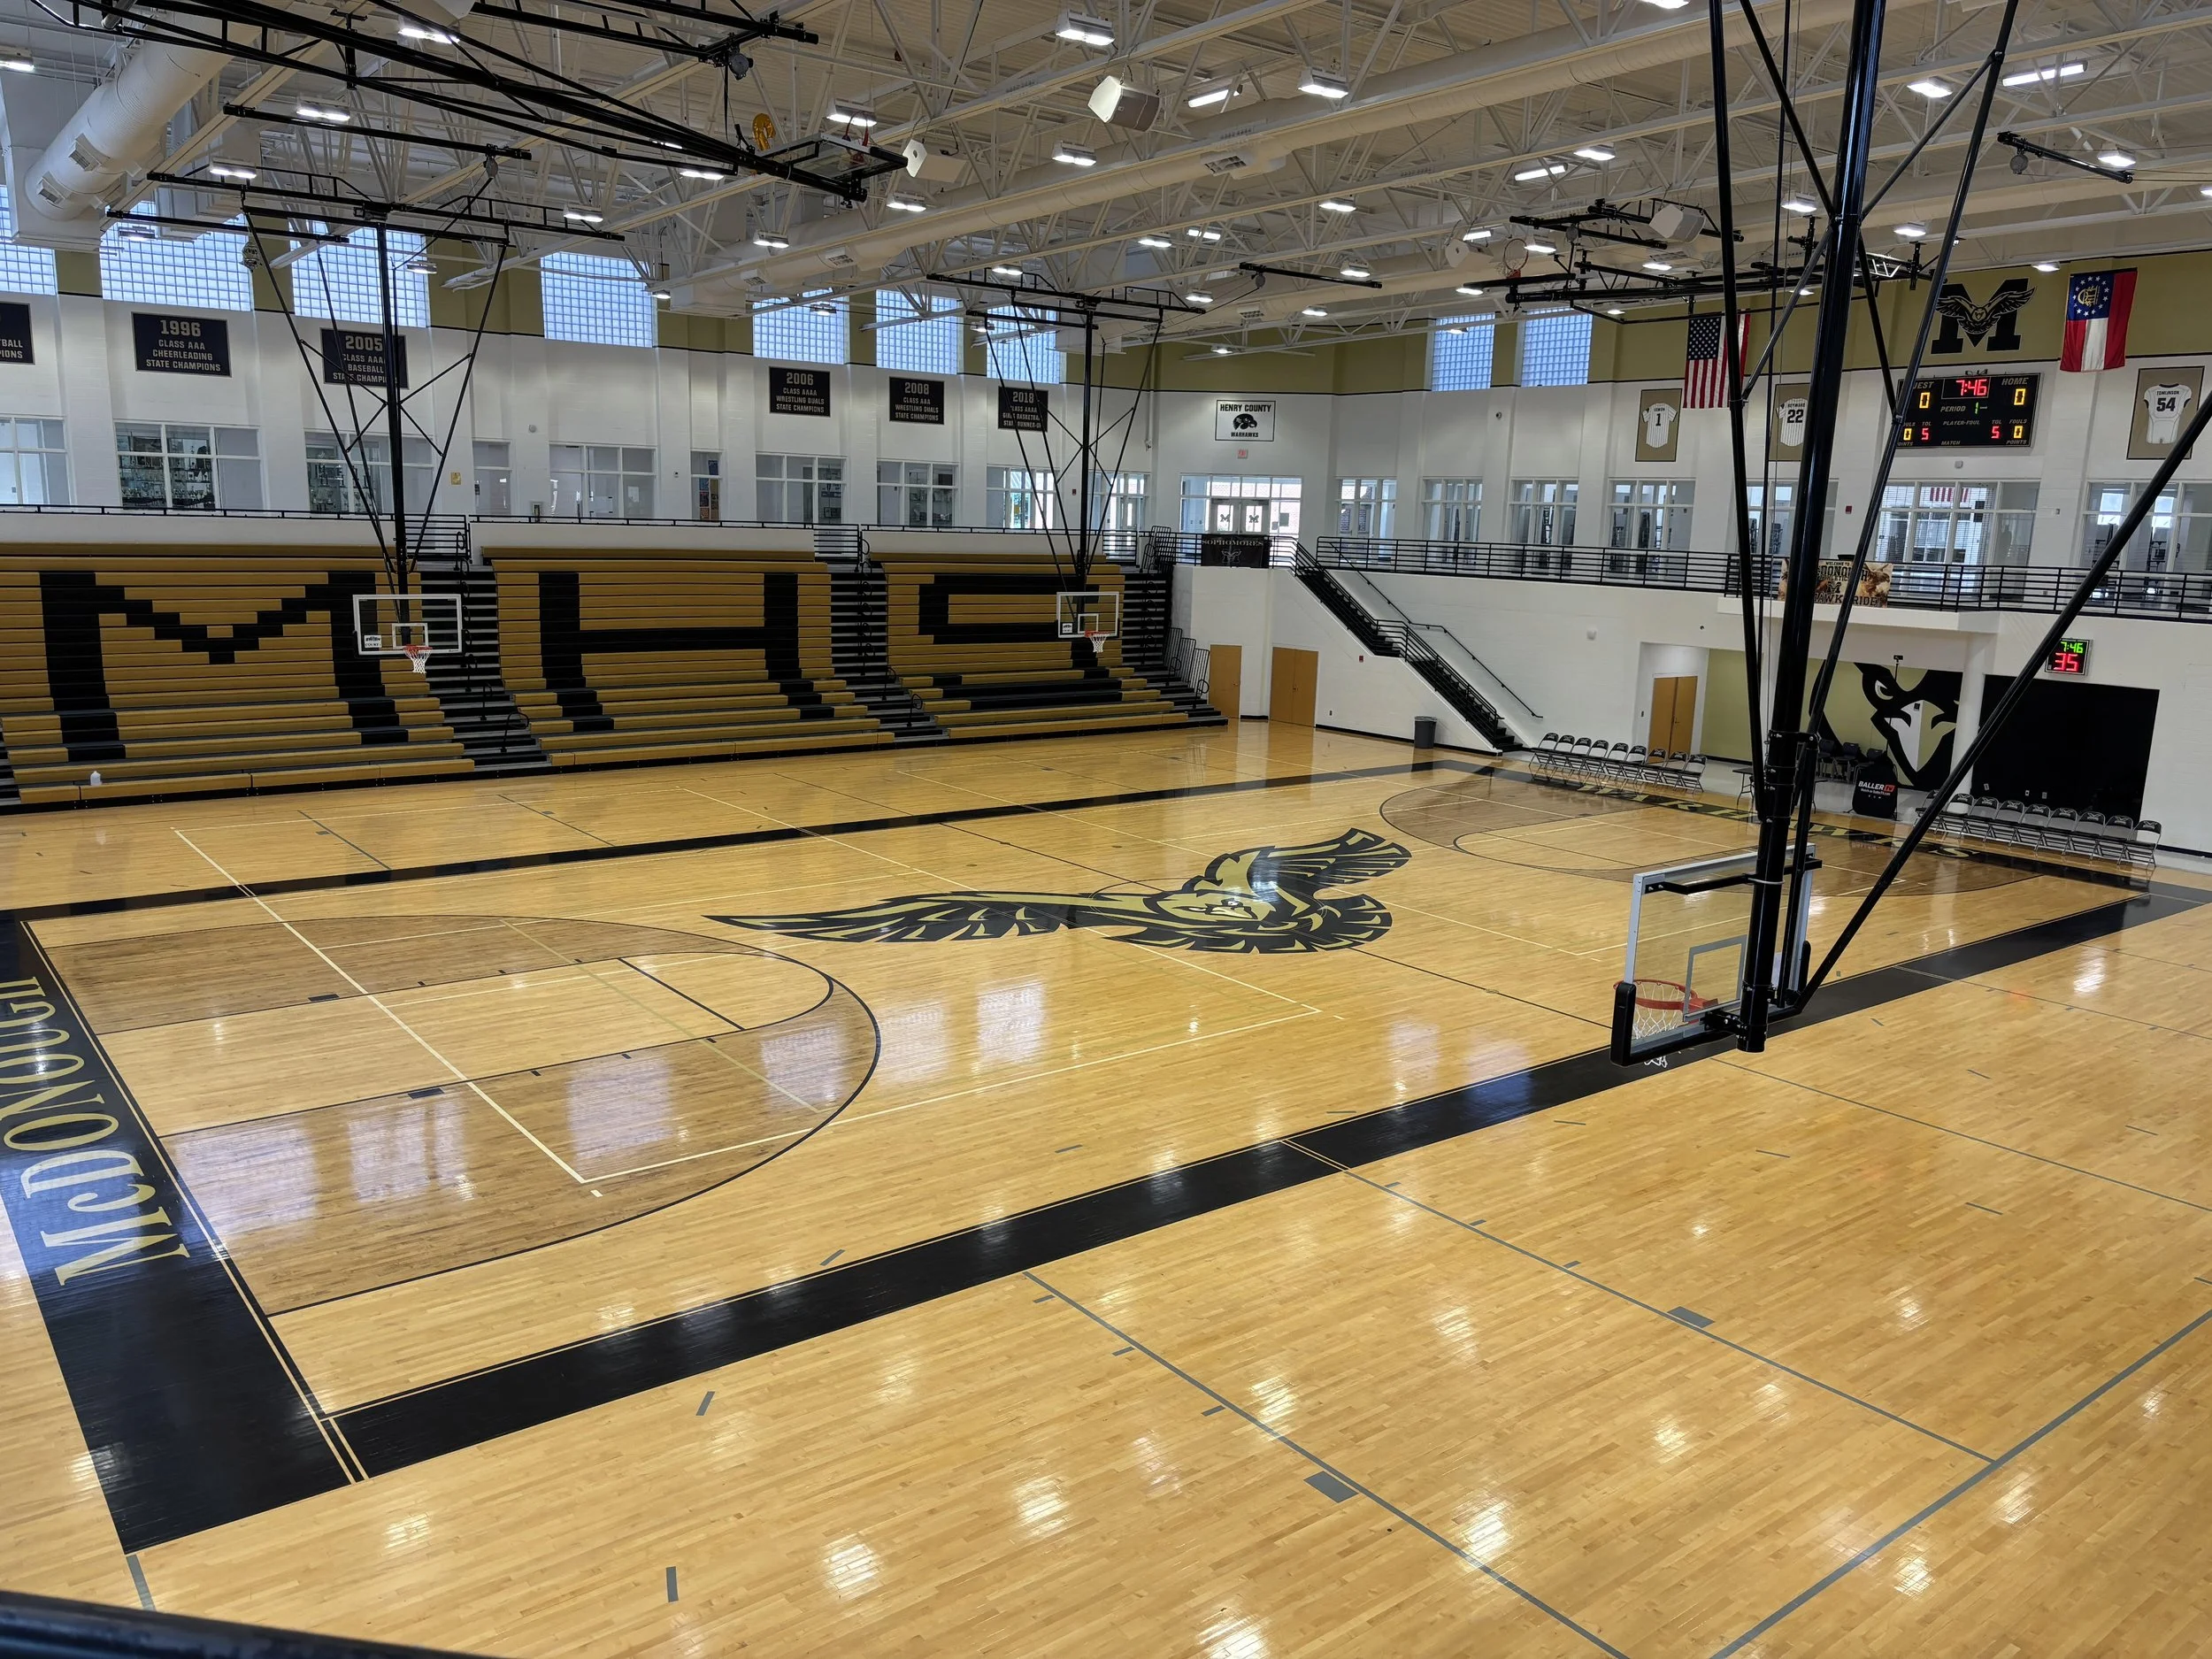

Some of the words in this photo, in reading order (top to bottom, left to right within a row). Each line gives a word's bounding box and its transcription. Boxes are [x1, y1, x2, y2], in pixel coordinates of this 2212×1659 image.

[160, 319, 202, 337] 1996
[0, 339, 23, 348] BALL
[158, 339, 185, 349] CLASS
[188, 342, 205, 350] AAA
[345, 336, 383, 351] 2005
[0, 349, 23, 358] IONS
[152, 349, 213, 361] CHEERLEADING
[146, 359, 170, 368] STATE
[173, 360, 221, 372] CHAMPIONS
[348, 364, 384, 373] BASEBALL
[787, 373, 814, 386] 2006
[904, 381, 929, 395] 2008
[1956, 379, 1988, 396] 7:46
[2001, 377, 2029, 386] HOME
[1012, 391, 1034, 403] 2018
[1918, 392, 1931, 409] 0
[2013, 388, 2026, 405] 0
[793, 404, 825, 413] CHAMPIONS
[2156, 397, 2177, 412] 54
[1655, 413, 1662, 426] 1
[1787, 409, 1804, 424] 22
[1903, 427, 1912, 441] 0
[1921, 428, 1930, 441] 5
[1991, 426, 2000, 439] 5
[2013, 426, 2024, 439] 0
[2061, 641, 2084, 653] 7:46
[2054, 653, 2079, 672] 35
[1858, 780, 1885, 790] BALLER
